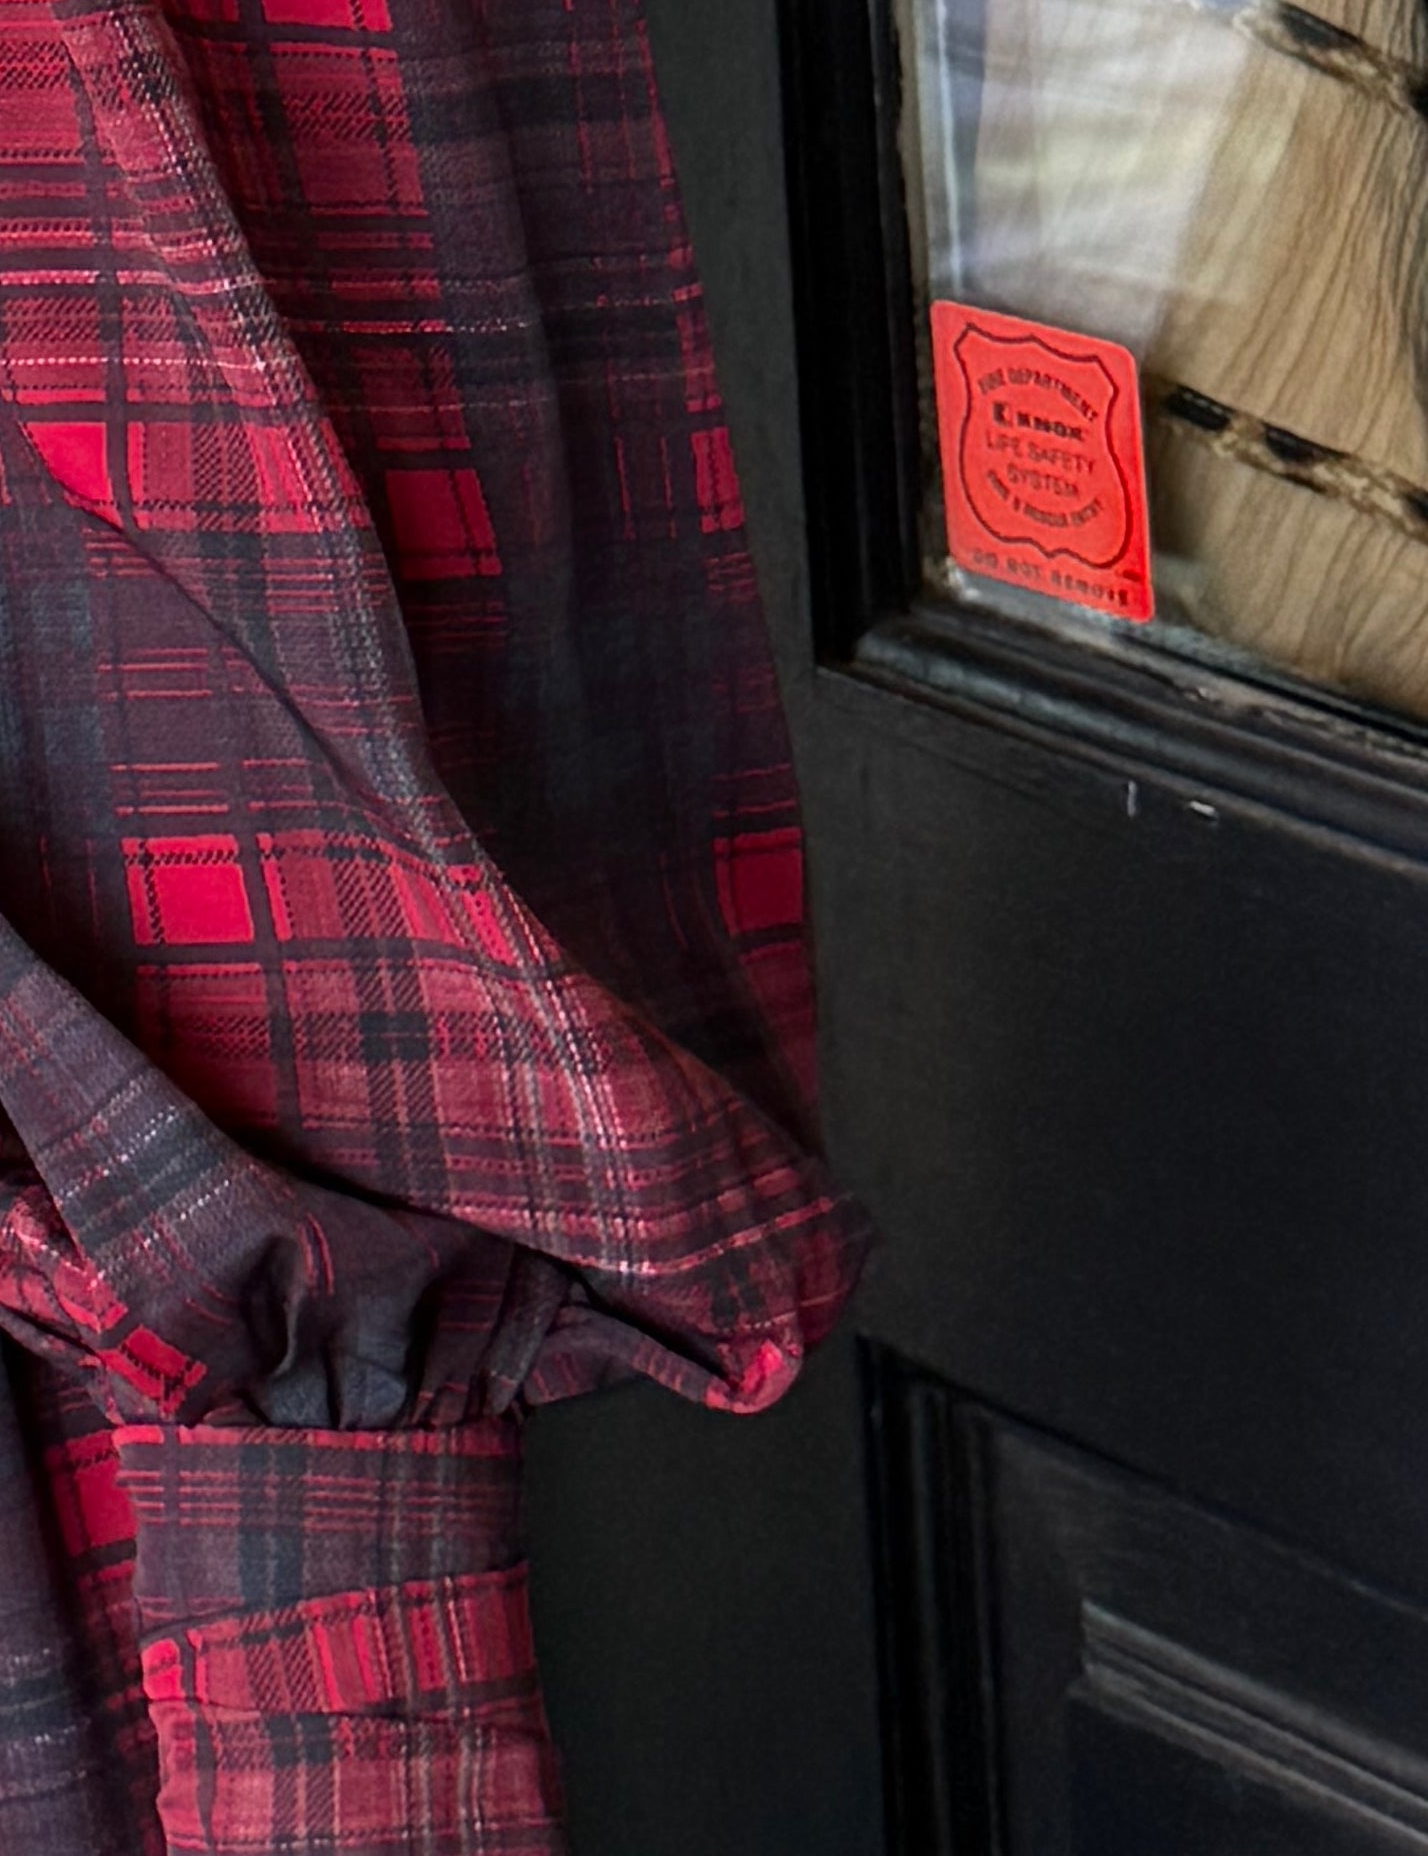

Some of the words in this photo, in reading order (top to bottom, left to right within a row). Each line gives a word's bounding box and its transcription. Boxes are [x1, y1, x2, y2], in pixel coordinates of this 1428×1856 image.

[1017, 410, 1084, 441] KNOX
[985, 429, 1022, 458] LIFE
[1028, 441, 1095, 475] SAFETY
[1007, 461, 1079, 498] SYSTEM
[1006, 556, 1041, 580] NOT
[1050, 569, 1129, 608] REMOVE
